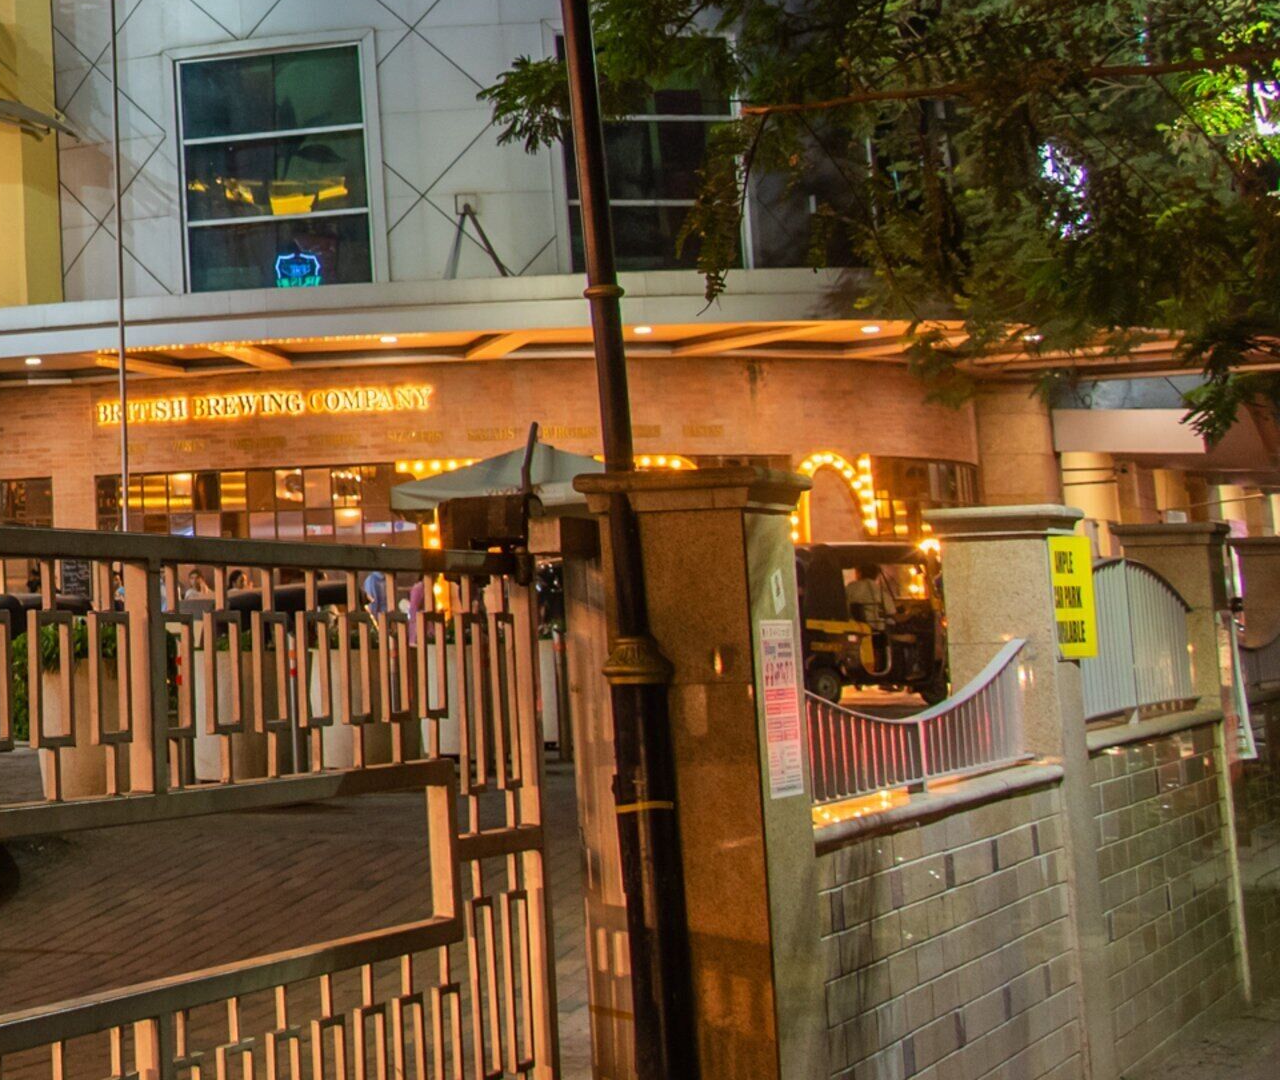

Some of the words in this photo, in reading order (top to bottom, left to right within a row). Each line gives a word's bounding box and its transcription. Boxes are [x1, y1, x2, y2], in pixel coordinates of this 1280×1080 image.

[97, 398, 188, 424] BRITISH
[192, 390, 304, 419] BREWING
[308, 385, 434, 415] COMPANY
[1064, 585, 1083, 608] PARK
